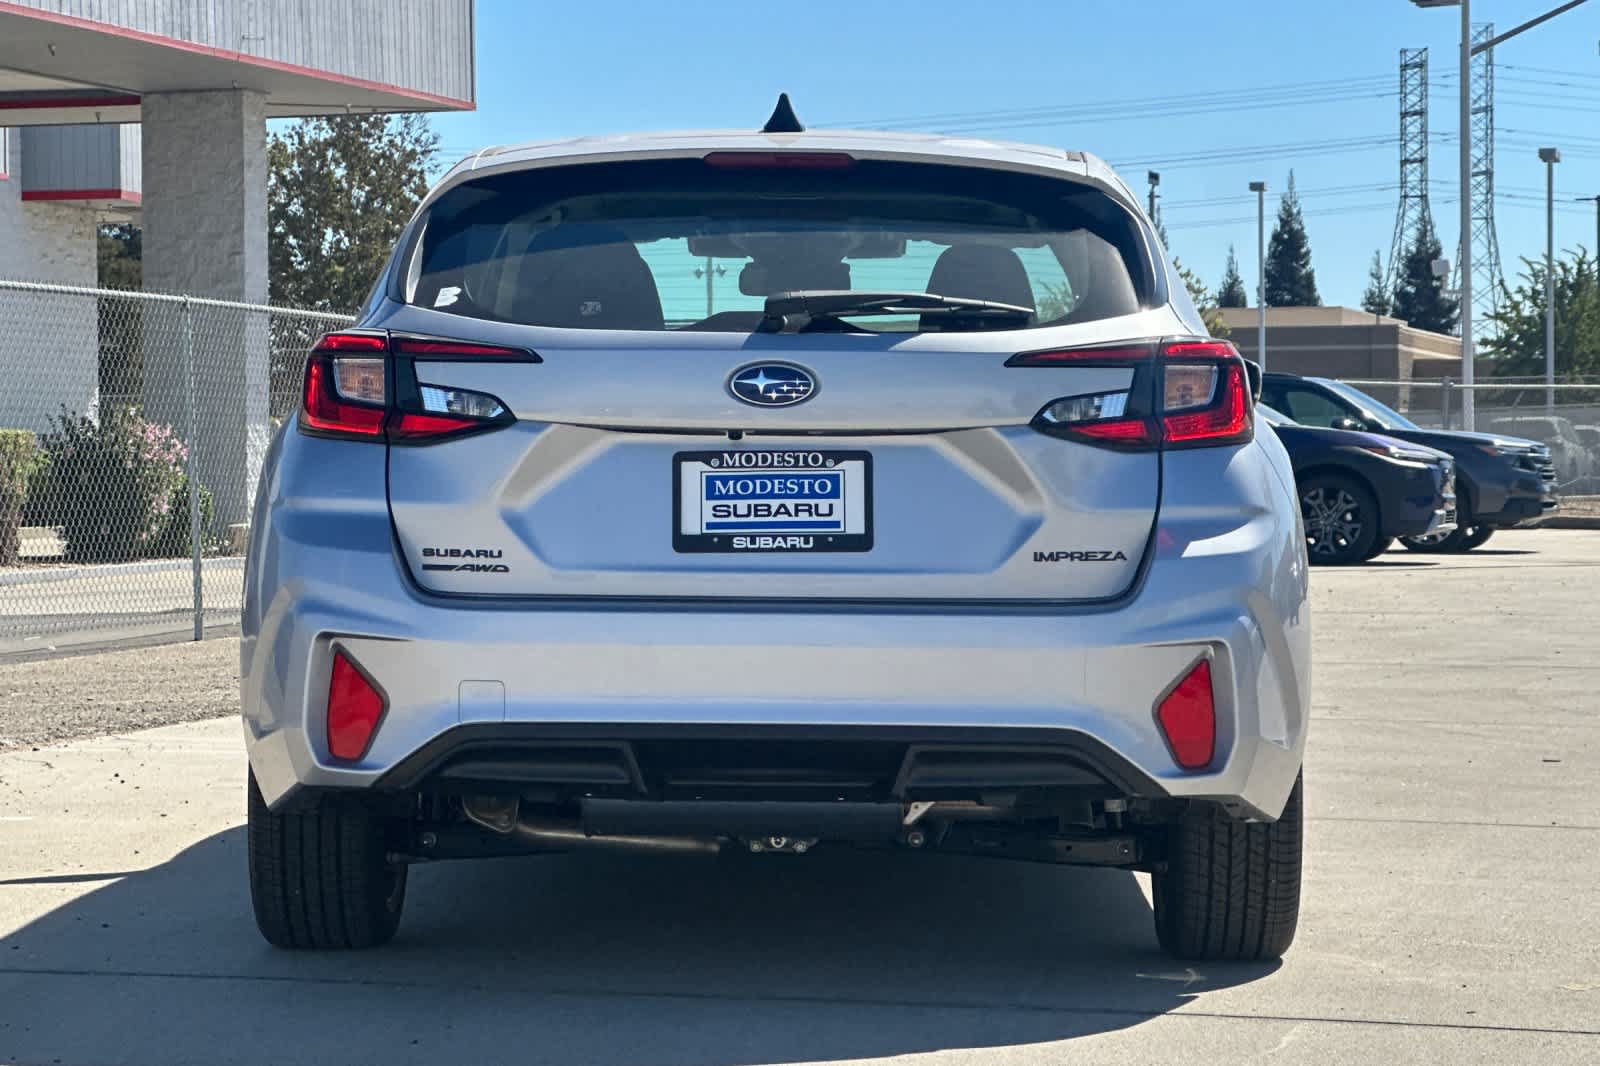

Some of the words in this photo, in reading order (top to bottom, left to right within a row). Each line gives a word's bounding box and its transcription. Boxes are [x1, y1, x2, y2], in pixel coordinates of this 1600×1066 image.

[722, 452, 824, 468] MODESTO
[713, 479, 833, 496] MODESTO
[711, 502, 834, 518] SUBARU
[732, 536, 814, 549] SUBARU
[422, 548, 503, 558] SUBARU
[1033, 551, 1128, 562] IMPREZA
[454, 564, 510, 573] AWD
